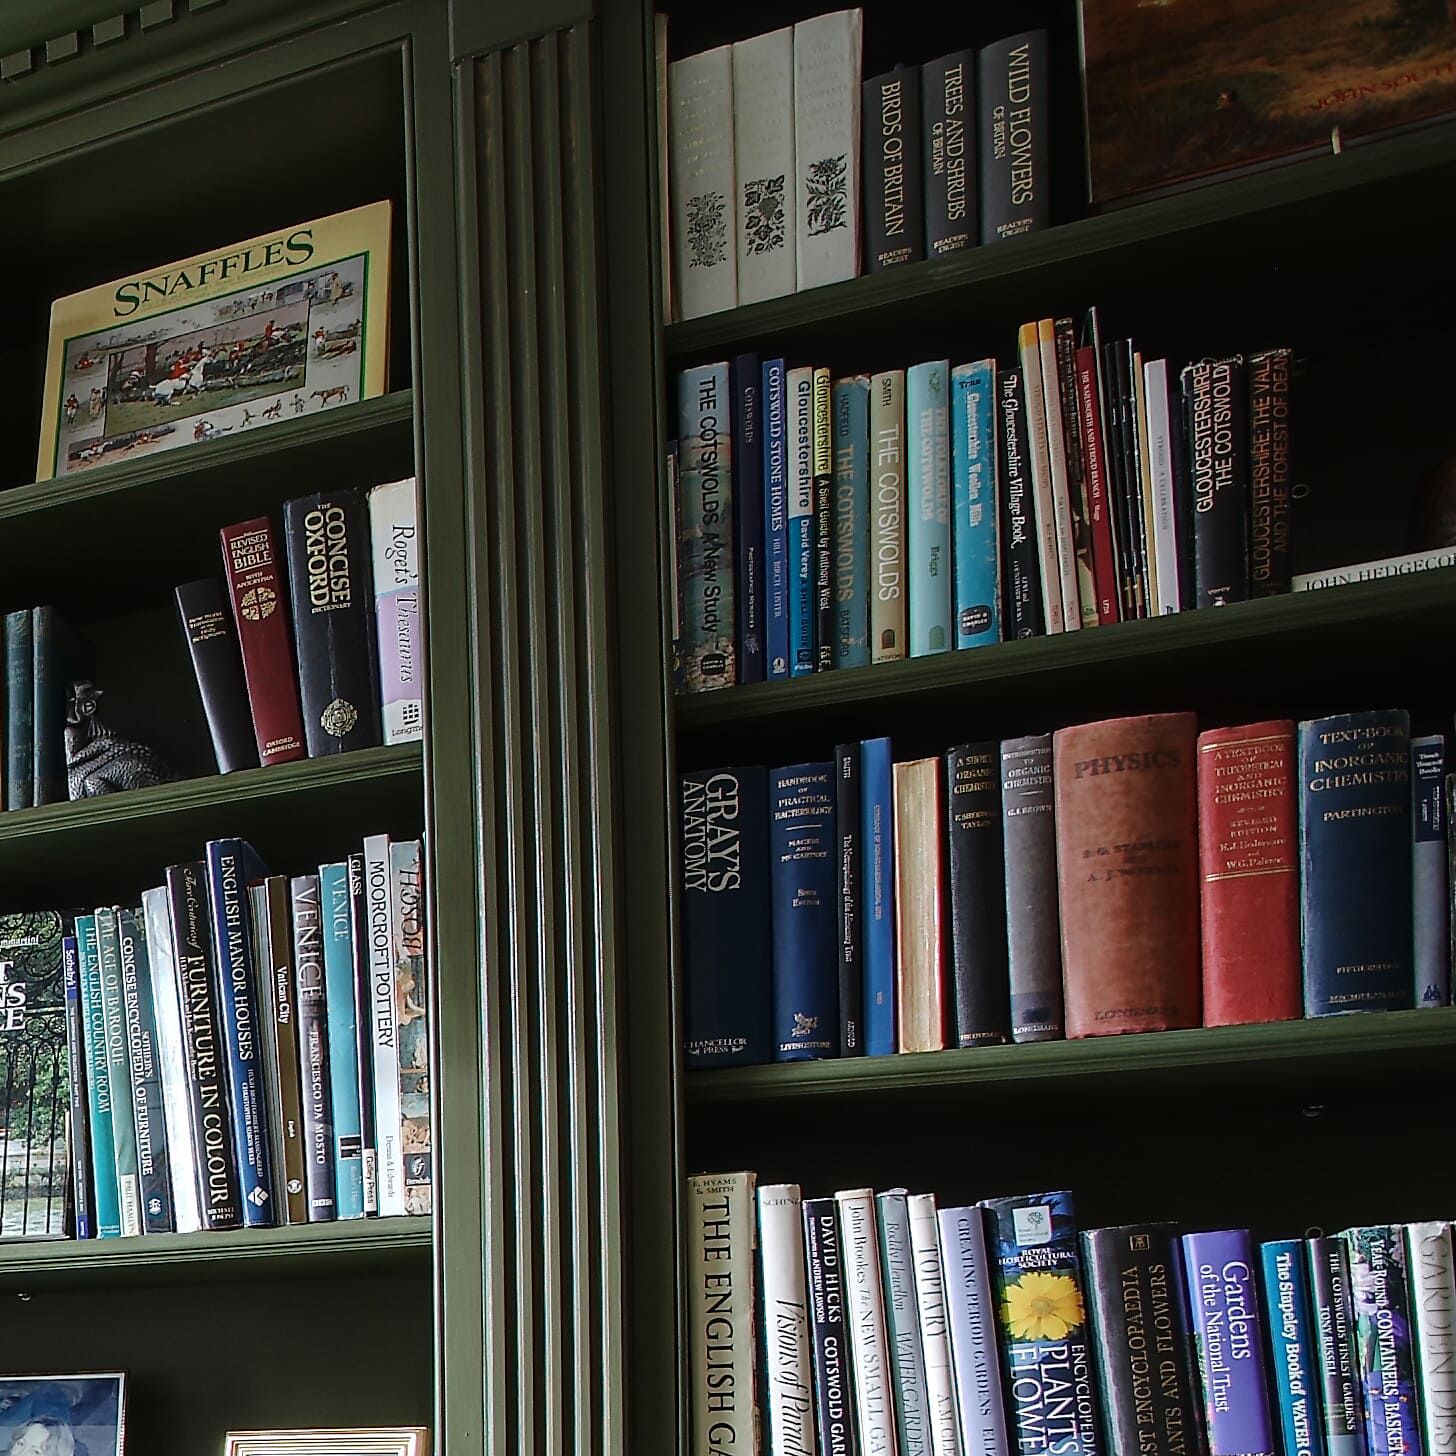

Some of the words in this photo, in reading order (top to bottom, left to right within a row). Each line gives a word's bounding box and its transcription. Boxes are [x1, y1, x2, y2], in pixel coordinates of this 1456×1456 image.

[944, 64, 964, 116] TREES
[1008, 43, 1031, 104] WILD
[880, 80, 902, 135] BIRDS
[883, 136, 903, 164] OF
[946, 117, 965, 157] AND
[1010, 106, 1034, 206] FLOWERS
[884, 164, 904, 237] BRITAIN
[947, 157, 966, 222] SHRUBS
[113, 229, 315, 318] SNAFFLES
[699, 376, 717, 414] THE
[769, 367, 781, 438] COTSWOLD
[1002, 373, 1017, 398] The
[1254, 395, 1272, 426] THE
[1273, 396, 1289, 418] OF
[799, 380, 812, 508] Gloucestershire
[815, 374, 831, 474] Gloucestershire
[878, 424, 899, 466] THE
[1002, 397, 1024, 478] Gloucestershire
[1193, 363, 1214, 514] GLOUCESTERSHIRE
[699, 417, 720, 527] COTSWOLDS
[770, 441, 782, 481] STONE
[836, 443, 854, 482] THE
[1215, 458, 1232, 491] THE
[1273, 422, 1289, 483] FOREST
[770, 483, 783, 532] HOMES
[1008, 476, 1025, 516] Village
[305, 511, 330, 606] OXFORD
[326, 507, 351, 604] CONCISE
[384, 523, 418, 585] Roget's
[799, 519, 811, 549] David
[837, 486, 855, 603] COTSWOLDS
[878, 472, 899, 602] COTSWOLDS
[1010, 516, 1027, 550] Book
[234, 551, 273, 571] BIBLE
[703, 546, 721, 583] New
[818, 551, 831, 587] Anthony
[702, 584, 722, 634] Study
[397, 591, 418, 683] Thesaurus
[1074, 751, 1181, 779] PHYSICS
[683, 779, 707, 894] ANATOMY
[705, 773, 741, 894] GRAY'S
[221, 856, 241, 926] ENGLISH
[351, 858, 363, 896] GLASS
[331, 876, 350, 942] VENICE
[368, 860, 391, 969] MOORCROFT
[103, 947, 117, 969] AGE
[122, 936, 137, 990] CONCISE
[227, 931, 247, 988] MANOR
[293, 886, 323, 1000] VENICE
[87, 953, 101, 1005] ENGLISH
[105, 973, 119, 996] OF
[276, 965, 288, 1000] Vatican
[187, 955, 217, 1081] FURNITURE
[234, 993, 254, 1061] HOUSES
[277, 1001, 291, 1025] City
[374, 972, 395, 1049] POTTERY
[91, 1011, 107, 1075] COUNTRY
[128, 991, 146, 1086] ENCYCLOPEDIA
[309, 1030, 324, 1101] FRANCESCO
[97, 1075, 110, 1113] ROOM
[135, 1087, 147, 1105] OF
[200, 1084, 220, 1110] IN
[313, 1103, 324, 1120] DA
[136, 1106, 153, 1176] FURNITURE
[203, 1113, 230, 1205] COLOUR
[314, 1123, 328, 1166] MOSTO
[702, 1196, 732, 1262] THE
[821, 1216, 838, 1267] DAVID
[849, 1206, 865, 1234] John
[853, 1236, 870, 1285] Brookes
[958, 1217, 977, 1289] CREATING
[1200, 1264, 1219, 1282] of
[1275, 1251, 1290, 1279] The
[1329, 1251, 1340, 1274] THE
[1370, 1240, 1389, 1307] YEAR-ROUND
[825, 1272, 842, 1324] HICKS
[919, 1243, 947, 1337] TOPIARY
[1148, 1263, 1175, 1354] FLOWERS
[1200, 1283, 1218, 1307] the
[1222, 1261, 1256, 1361] Gardens
[1330, 1275, 1347, 1337] COTSWOLDS
[1419, 1234, 1455, 1374] GARDEN
[704, 1272, 735, 1414] ENGLISH
[776, 1299, 805, 1369] Visions
[861, 1311, 877, 1347] NEW
[967, 1292, 984, 1346] PERIOD
[1121, 1265, 1155, 1425] ENCYCLOPAEDIA
[1205, 1310, 1231, 1372] National
[1319, 1305, 1334, 1335] TONY
[823, 1336, 845, 1422] COTSWOLD
[1159, 1360, 1180, 1399] AND
[1285, 1342, 1304, 1384] Book
[1322, 1336, 1338, 1377] RUSSELL
[1338, 1337, 1352, 1377] FINEST
[1376, 1308, 1401, 1401] CONTAINERS,
[864, 1353, 884, 1416] SMALL
[973, 1350, 993, 1417] GARDENS
[1038, 1346, 1080, 1455] PLANTS
[1212, 1373, 1232, 1413] Trust
[1342, 1381, 1357, 1431] GARDENS
[1291, 1399, 1311, 1446] WATER
